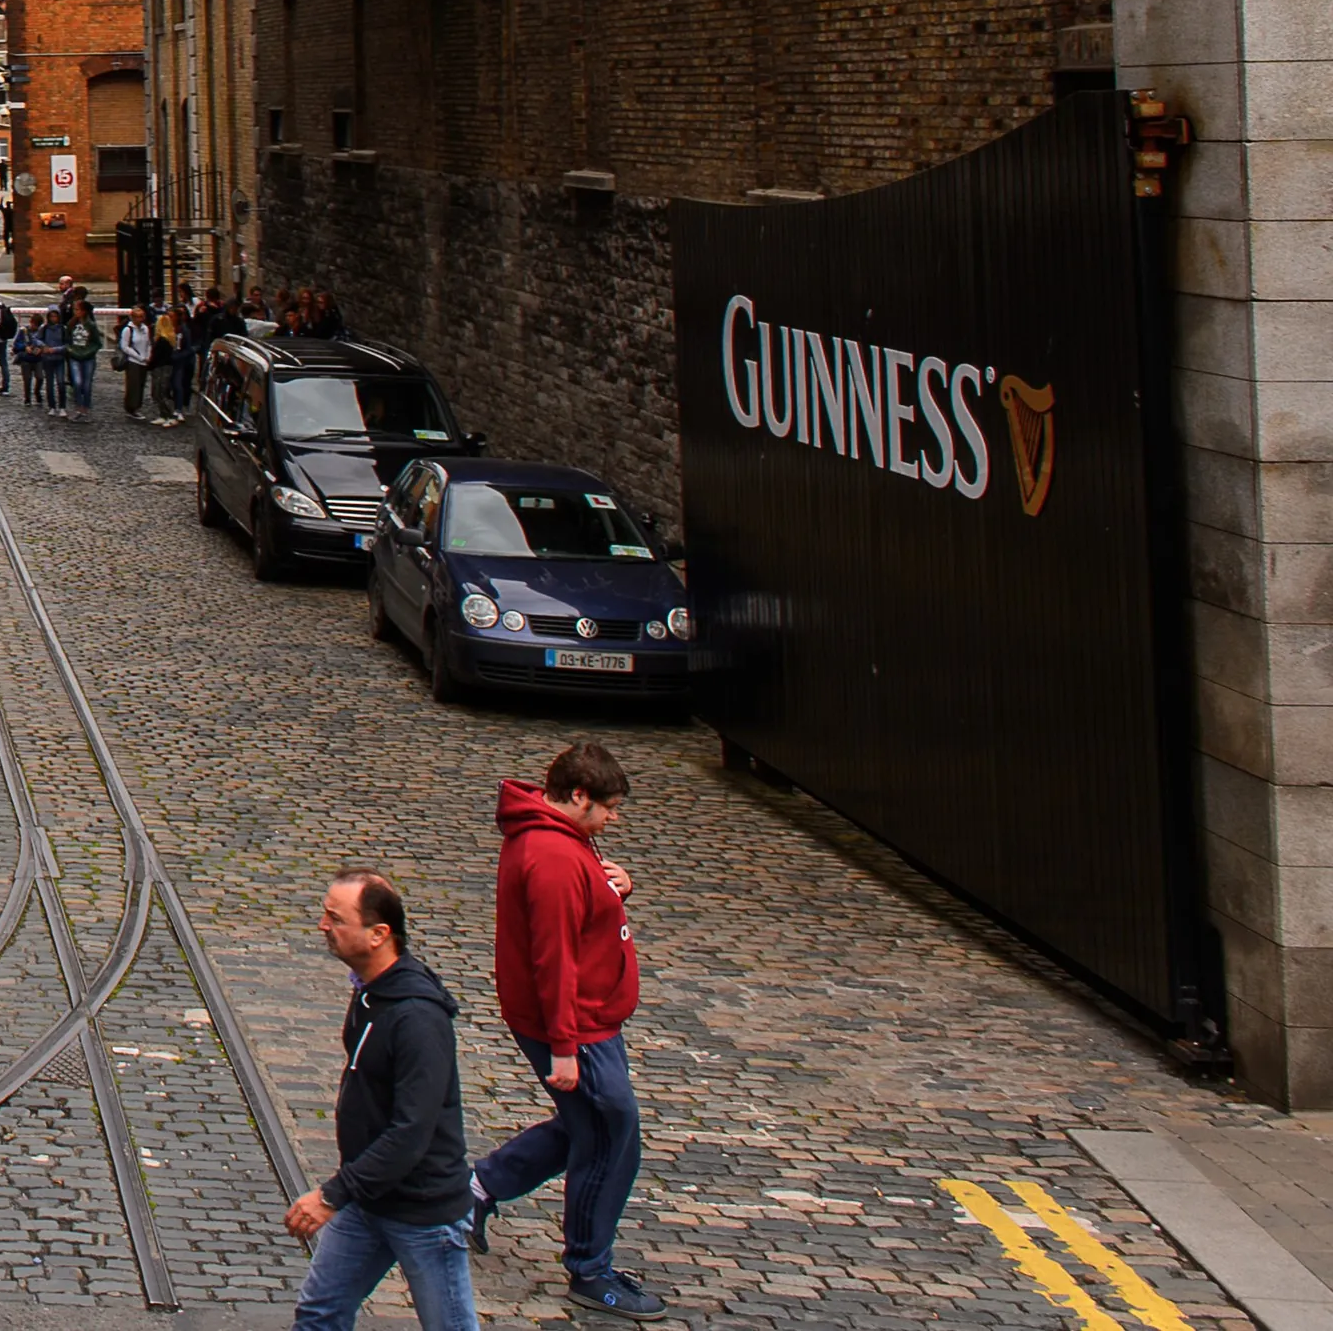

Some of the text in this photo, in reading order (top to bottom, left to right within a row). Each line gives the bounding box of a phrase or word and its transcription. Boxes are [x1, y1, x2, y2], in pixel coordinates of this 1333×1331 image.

[722, 294, 990, 500] GUINNESS
[592, 496, 610, 507] L
[559, 653, 626, 669] 03-KE-1776
